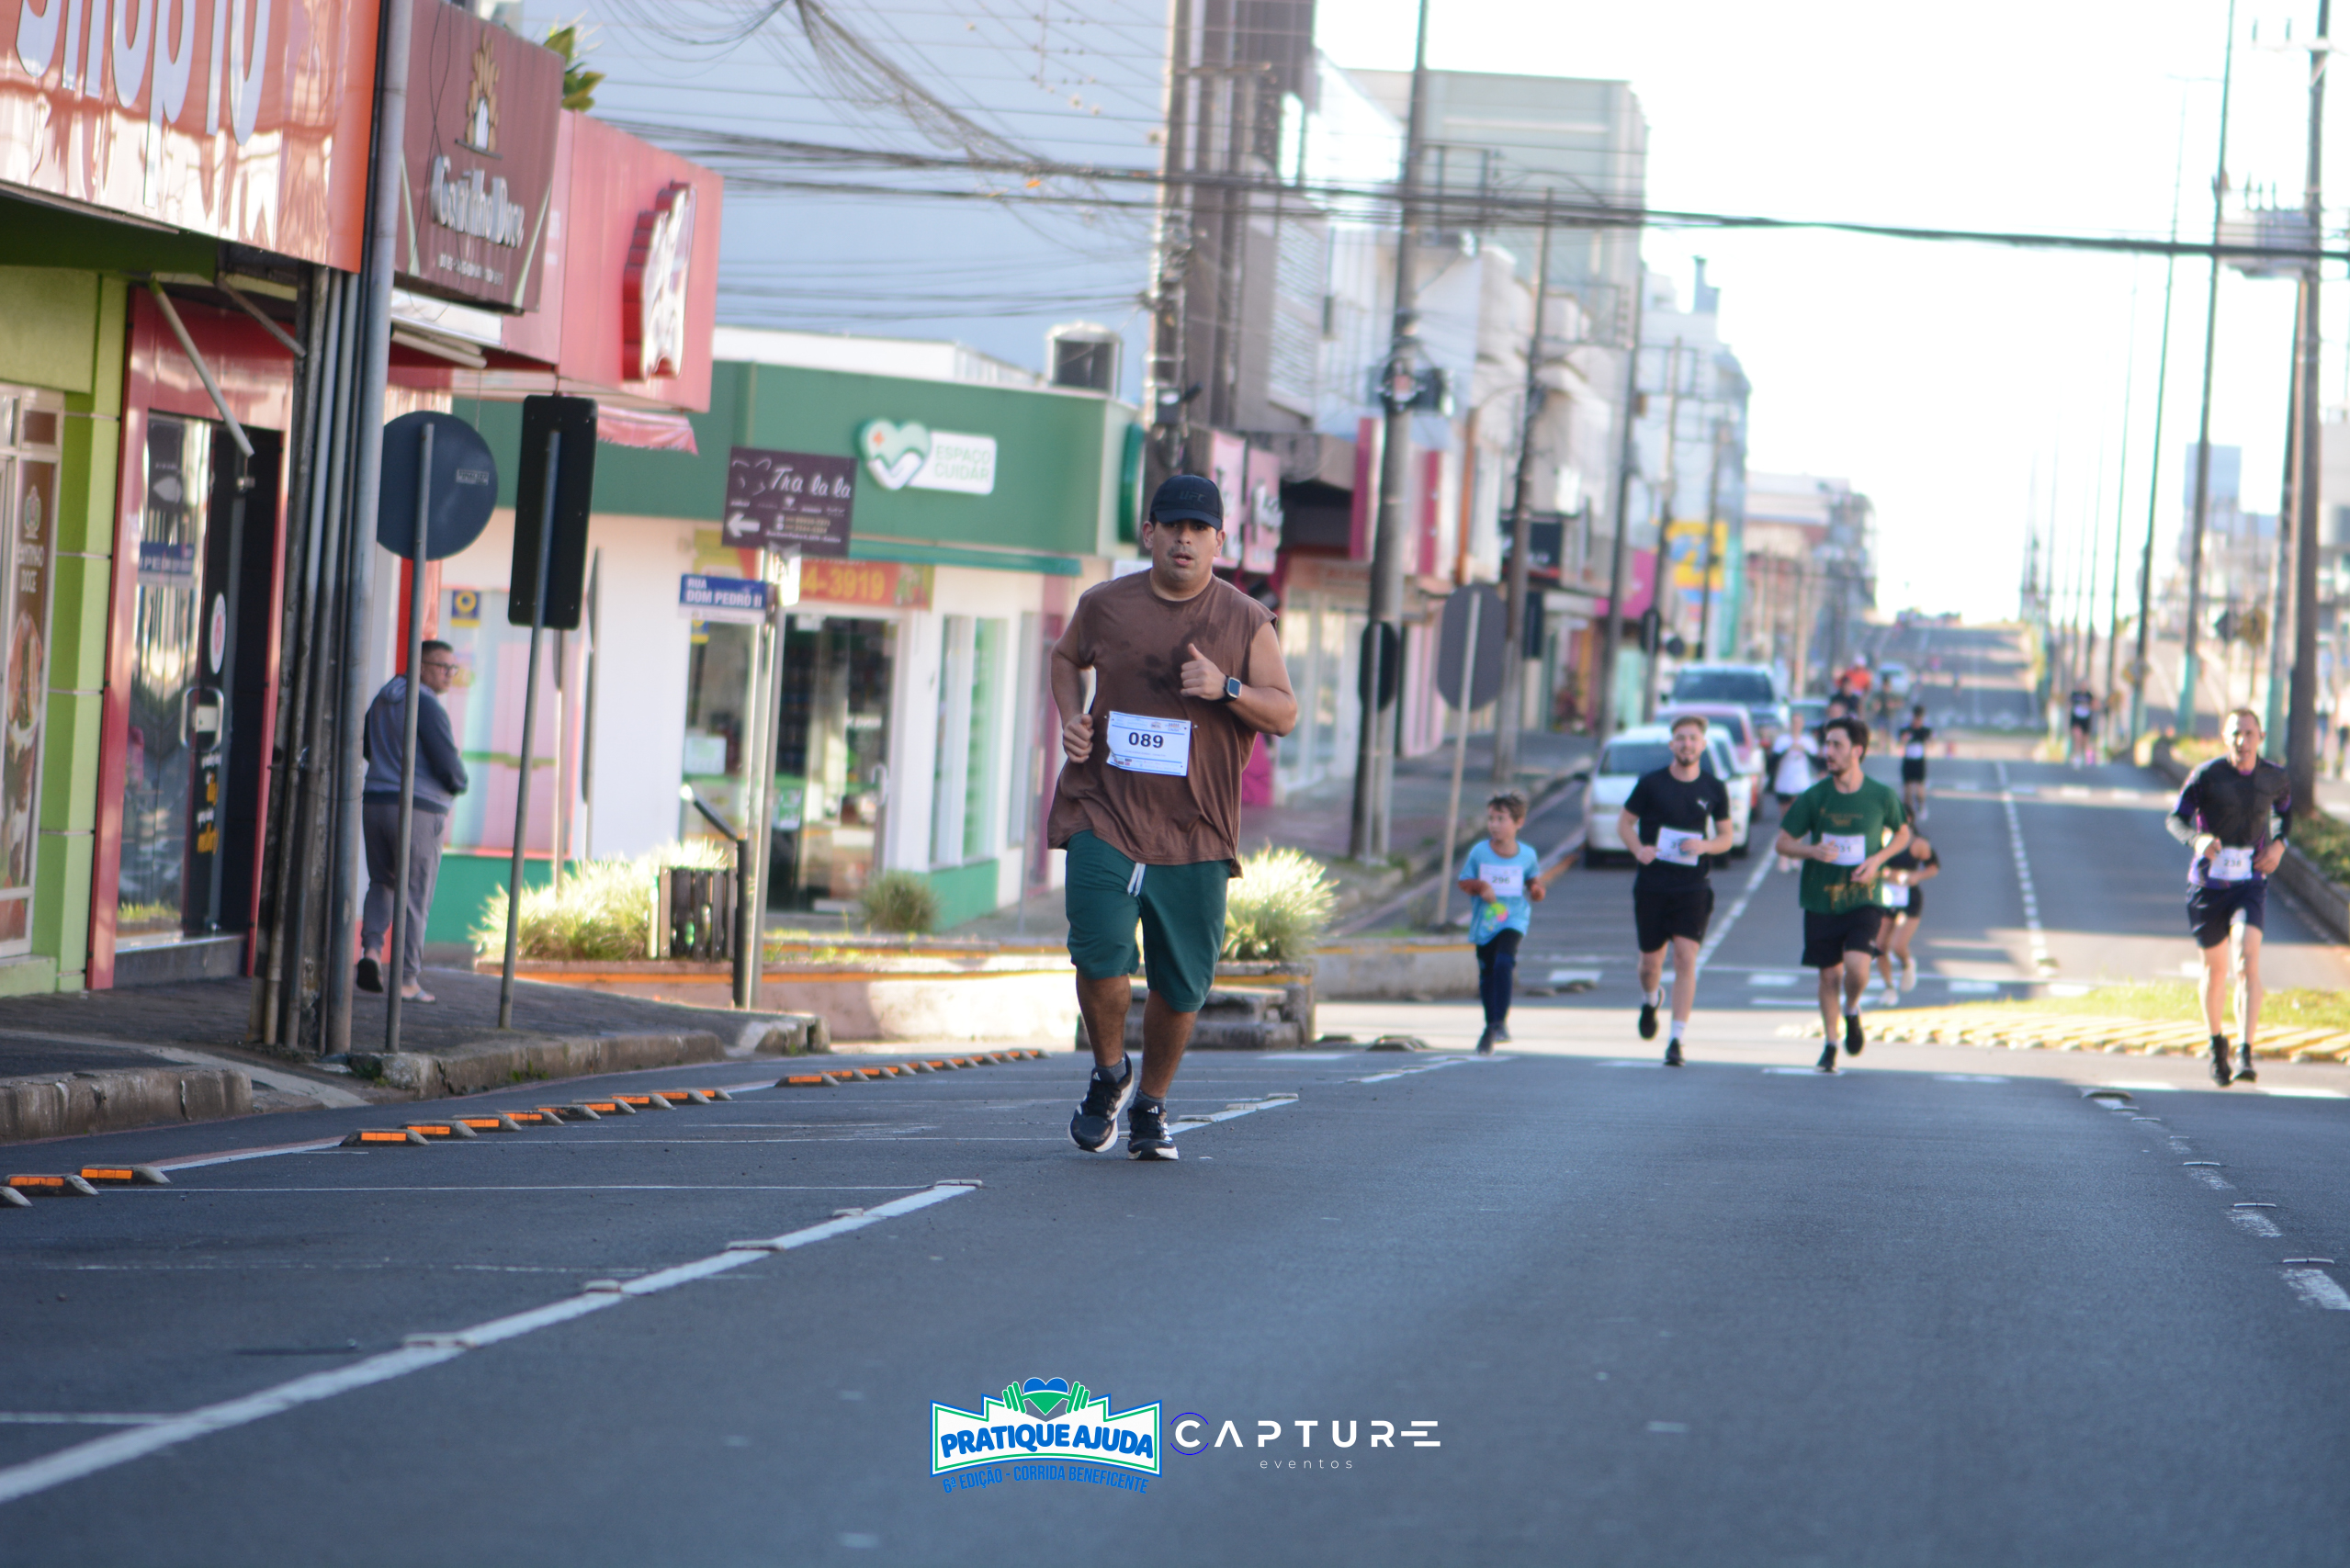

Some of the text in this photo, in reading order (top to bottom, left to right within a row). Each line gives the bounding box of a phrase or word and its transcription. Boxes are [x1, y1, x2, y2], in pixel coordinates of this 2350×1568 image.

[934, 462, 989, 482] CUIDAR
[810, 474, 829, 496] la
[833, 475, 852, 498] la
[1179, 491, 1206, 504] UFC
[687, 578, 707, 589] RUA
[800, 565, 886, 602] 4-3919
[686, 590, 763, 608] DOM PEDRO II
[1128, 731, 1164, 749] 089
[1492, 875, 1511, 885] 296
